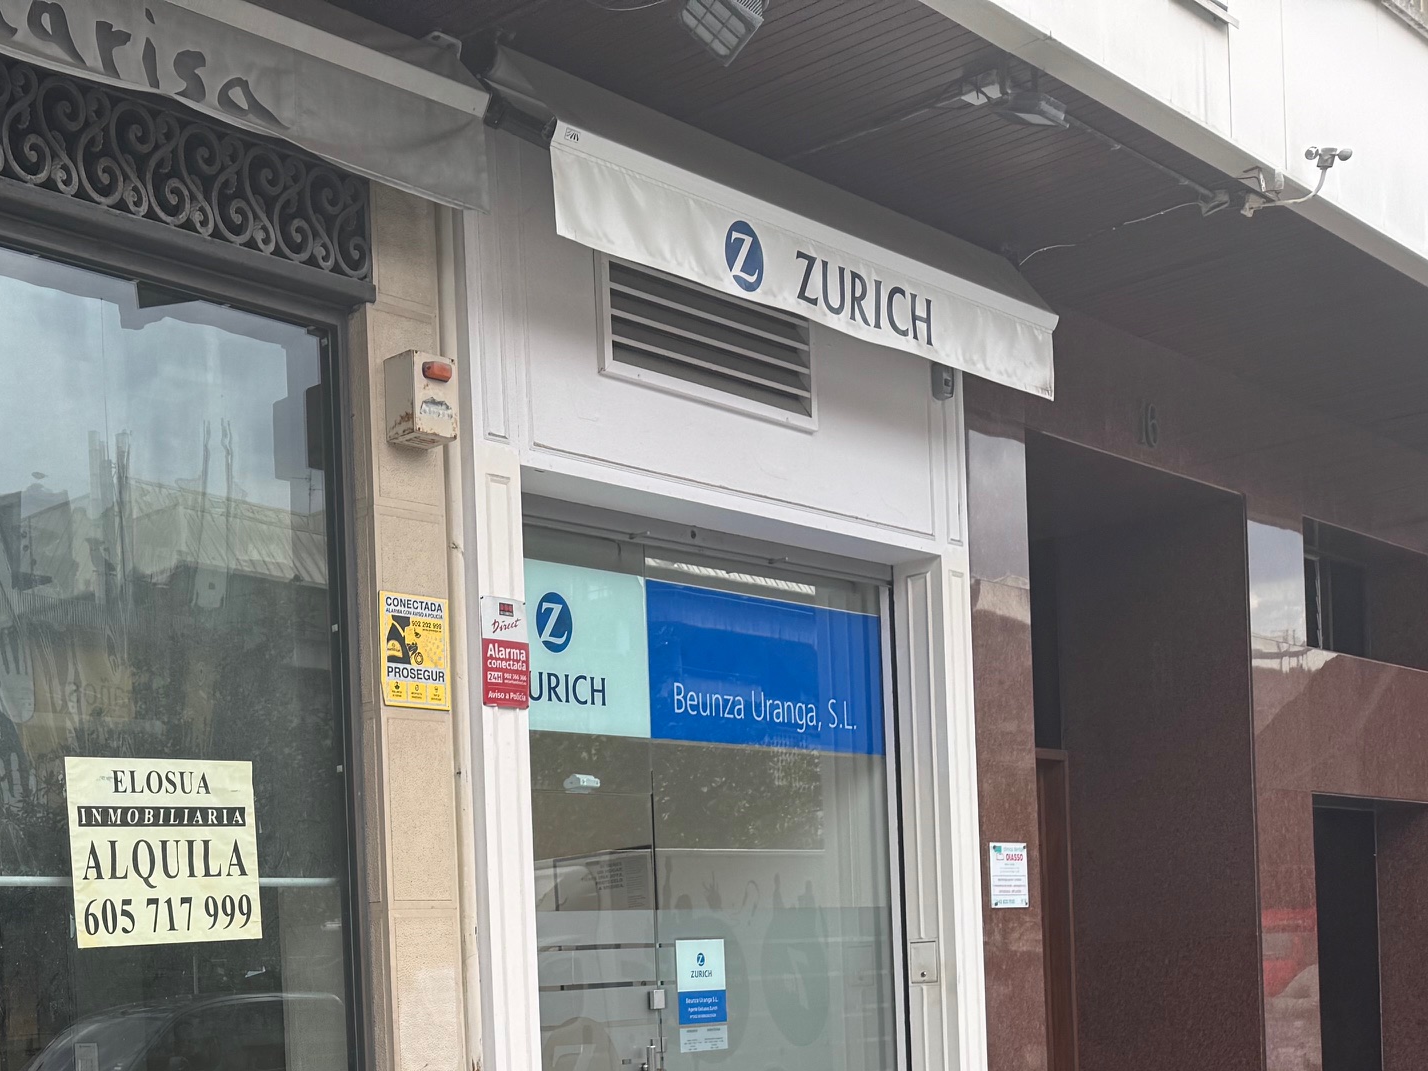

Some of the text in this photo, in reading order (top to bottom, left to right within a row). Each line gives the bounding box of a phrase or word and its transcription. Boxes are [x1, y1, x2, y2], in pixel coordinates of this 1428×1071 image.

[794, 250, 934, 347] ZURICH
[385, 596, 443, 613] CONECTADA
[385, 607, 403, 615] ALARMA
[491, 618, 521, 634] Direct
[487, 643, 526, 661] Alarma
[387, 665, 445, 683] PROSEGUR
[487, 659, 527, 671] conectada
[488, 671, 502, 682] 24H
[488, 690, 505, 699] Aviso
[510, 692, 526, 702] Policía
[673, 682, 857, 733] Beunza Uranga, S.L.
[111, 769, 212, 796] ELOSUA
[79, 807, 244, 825] INMOBILIARIA
[82, 838, 249, 889] ALQUILA
[84, 894, 252, 936] 605 717 999
[690, 969, 713, 979] ZURICH
